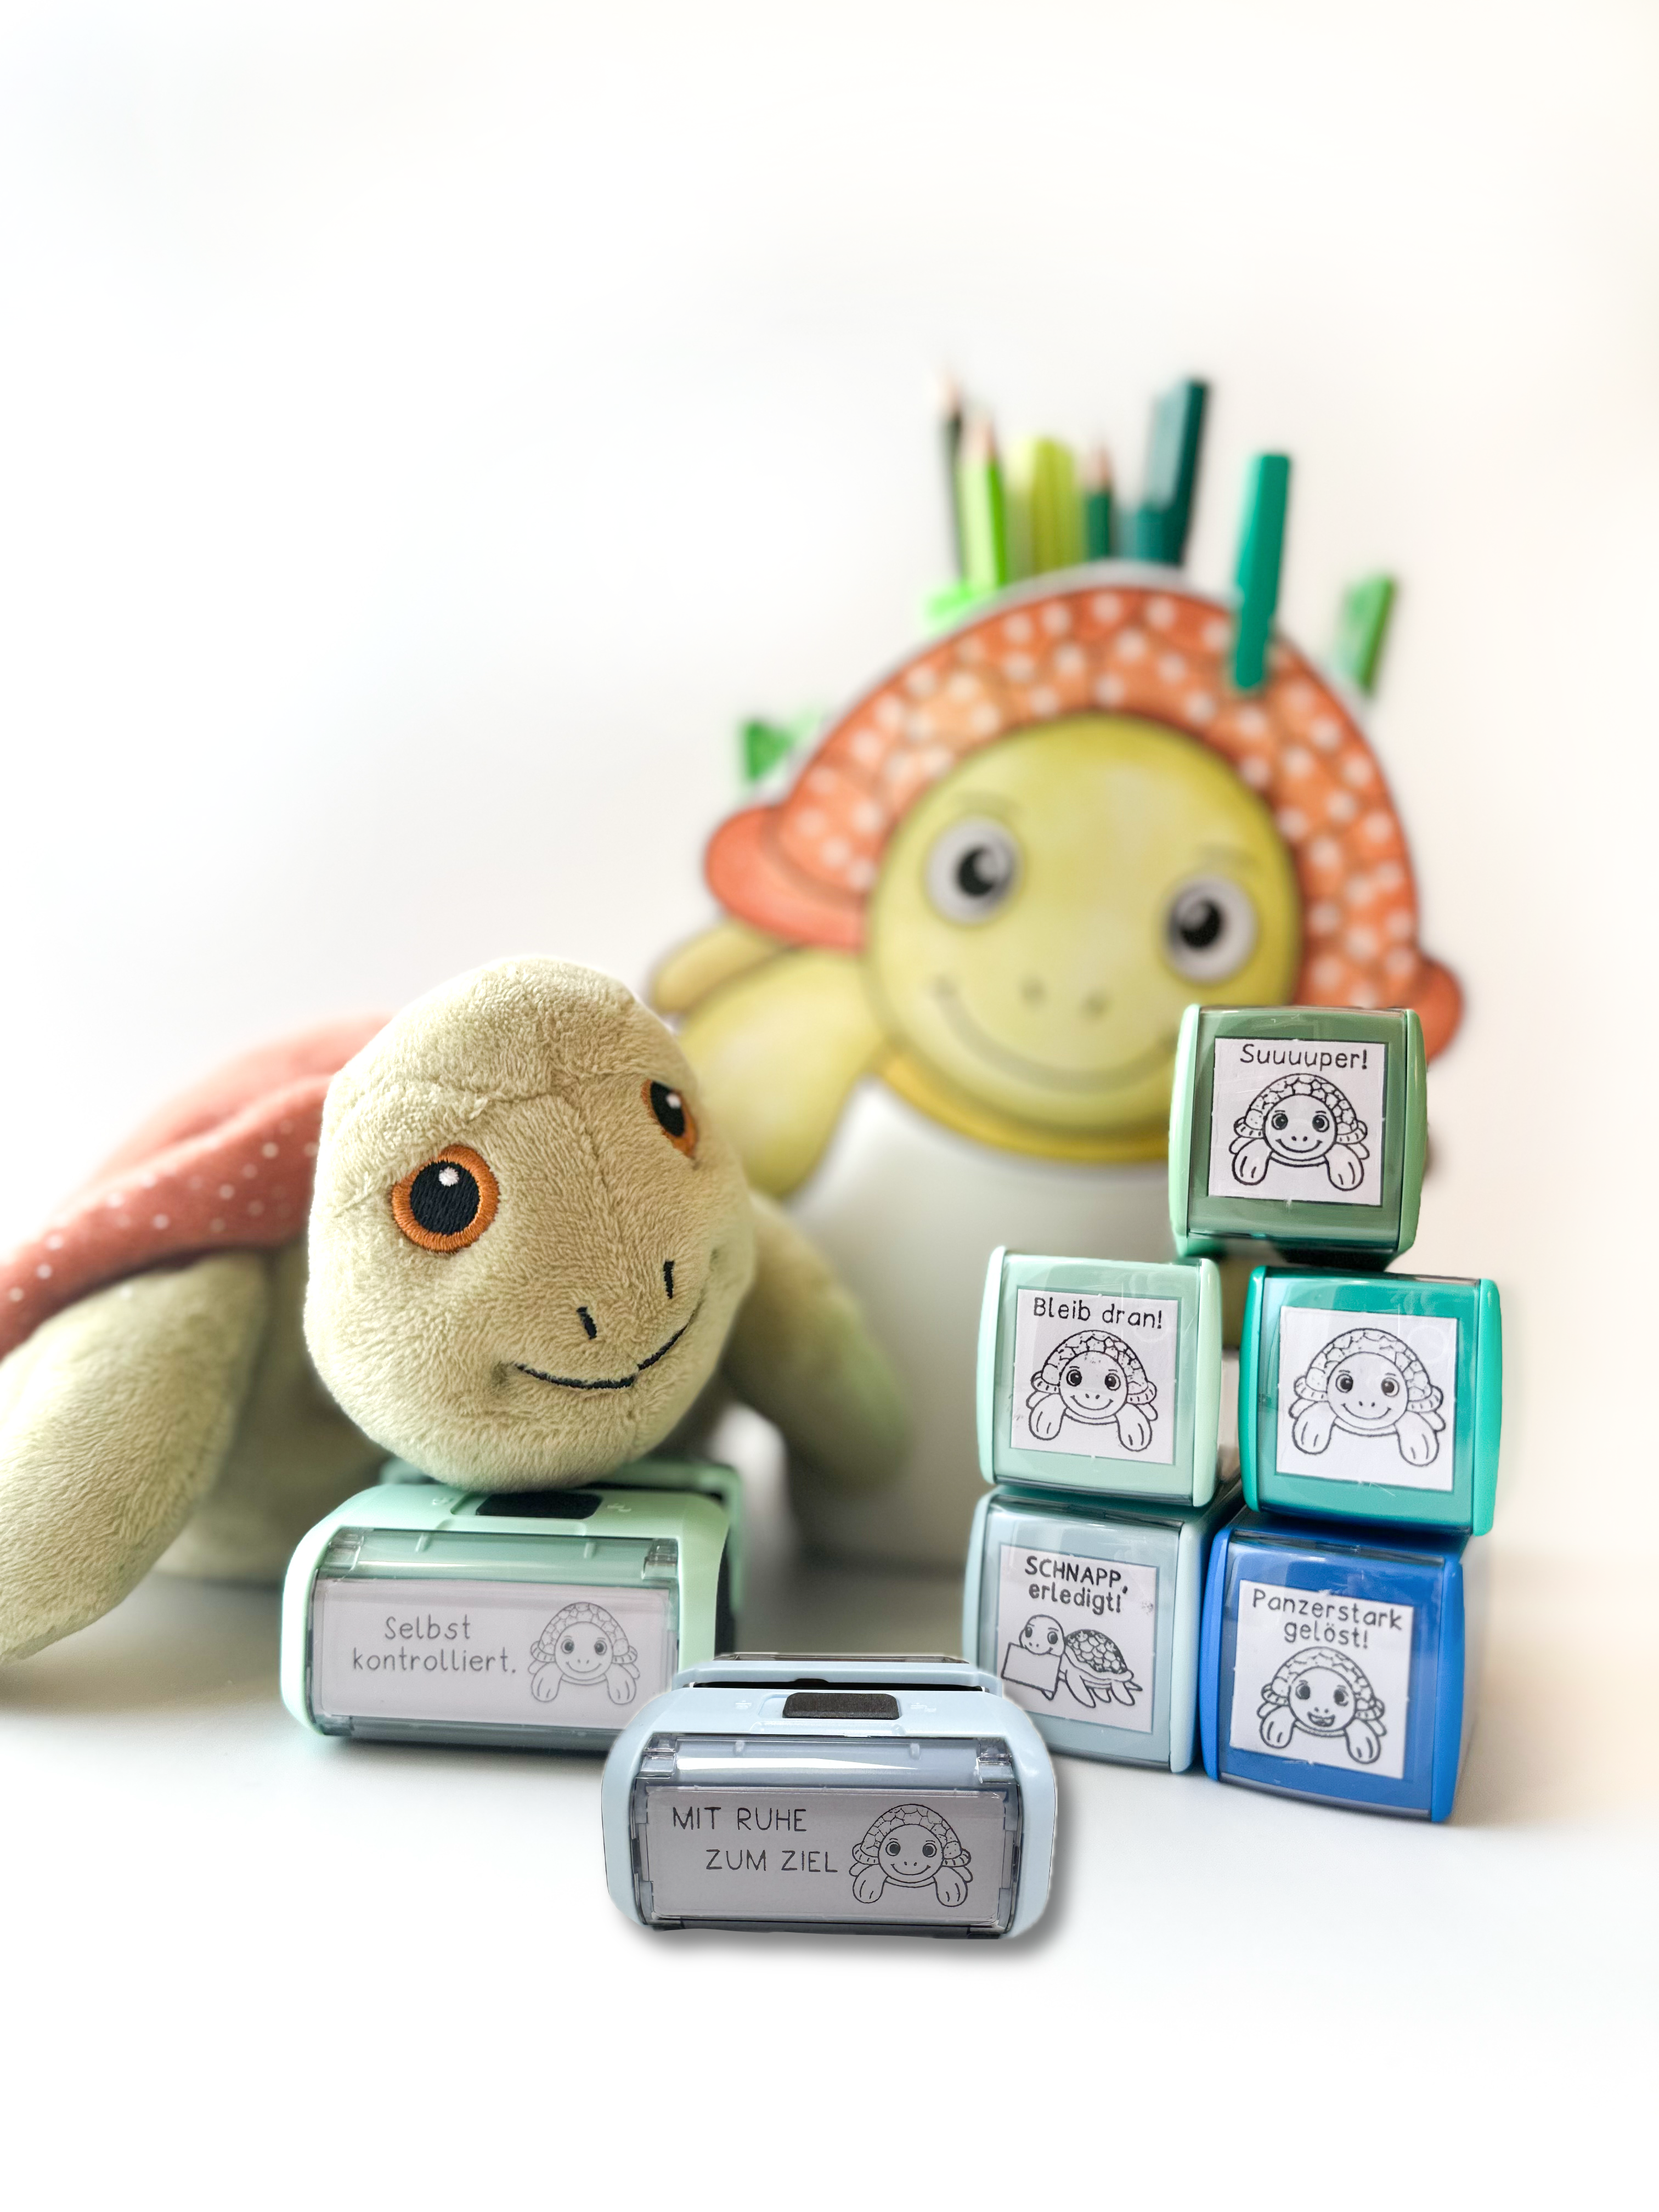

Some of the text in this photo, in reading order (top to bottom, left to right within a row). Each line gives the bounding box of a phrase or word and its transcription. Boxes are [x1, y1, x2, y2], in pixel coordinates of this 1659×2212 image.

[1240, 1043, 1368, 1071] Suuuuper!
[1034, 1296, 1162, 1329] Bleib dran!
[1025, 1555, 1128, 1594] SCHNAPP,
[1029, 1582, 1121, 1615] erledigt!
[1252, 1589, 1402, 1630] Panzerstark
[385, 1614, 471, 1640] Selbst
[1284, 1620, 1368, 1649] gelöst!
[353, 1646, 516, 1673] kontrolliert.
[673, 1807, 807, 1831] MIT RUHE
[706, 1849, 838, 1872] ZUM ZIEL
